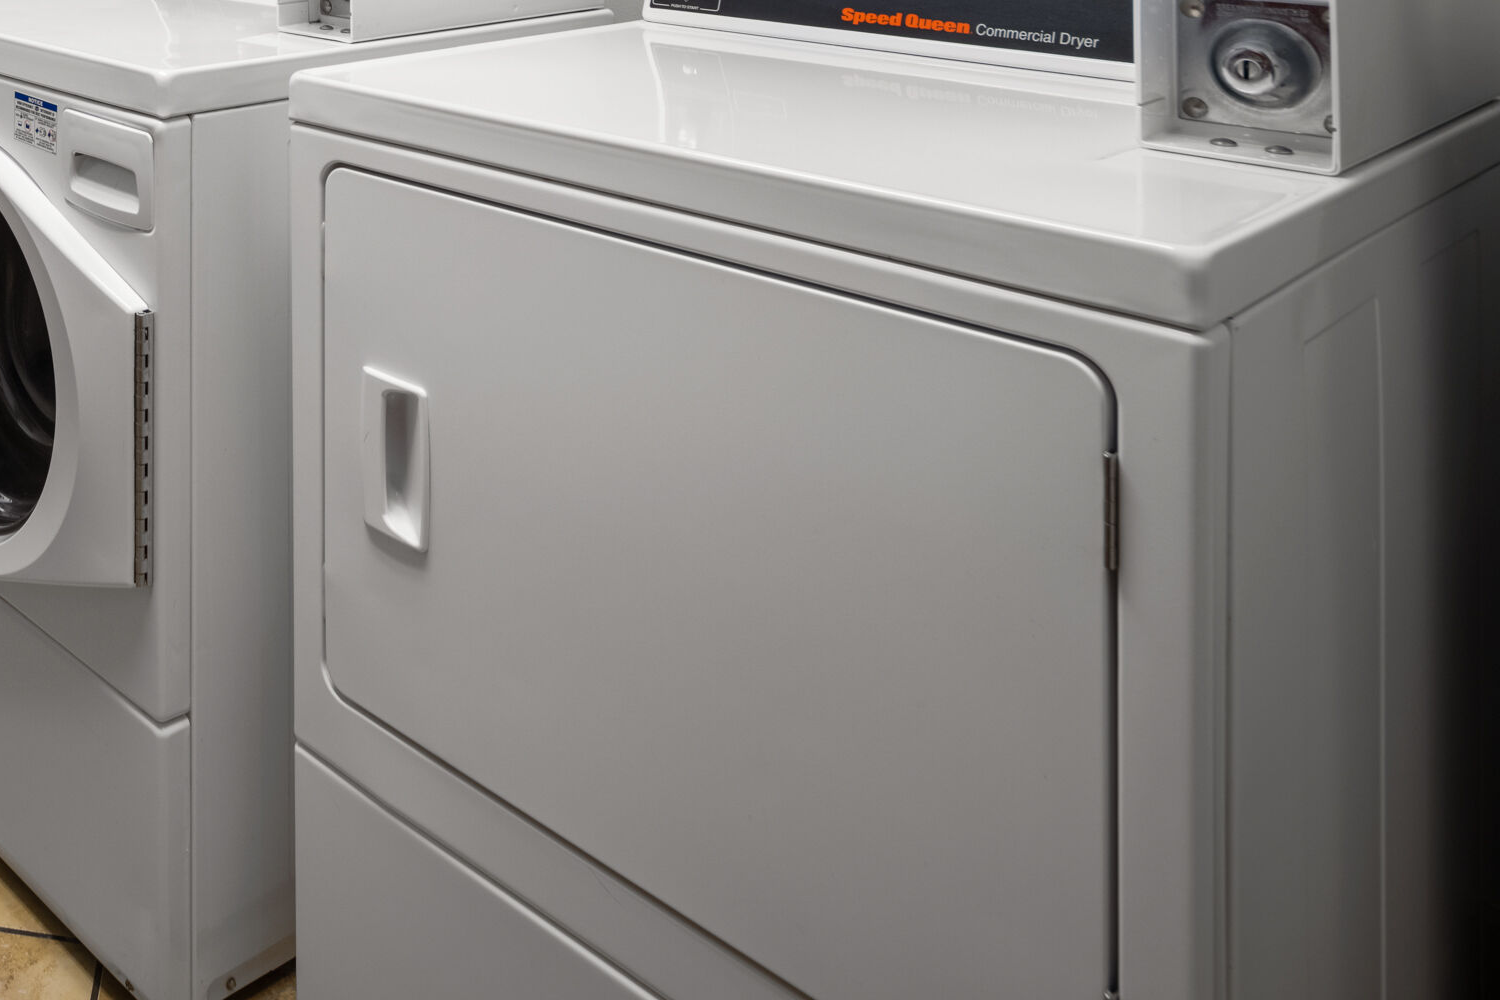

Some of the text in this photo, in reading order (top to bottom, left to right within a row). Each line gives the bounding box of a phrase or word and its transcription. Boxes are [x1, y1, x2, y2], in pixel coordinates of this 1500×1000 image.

[841, 7, 1100, 50] Speed Queen Commercial Dryer
